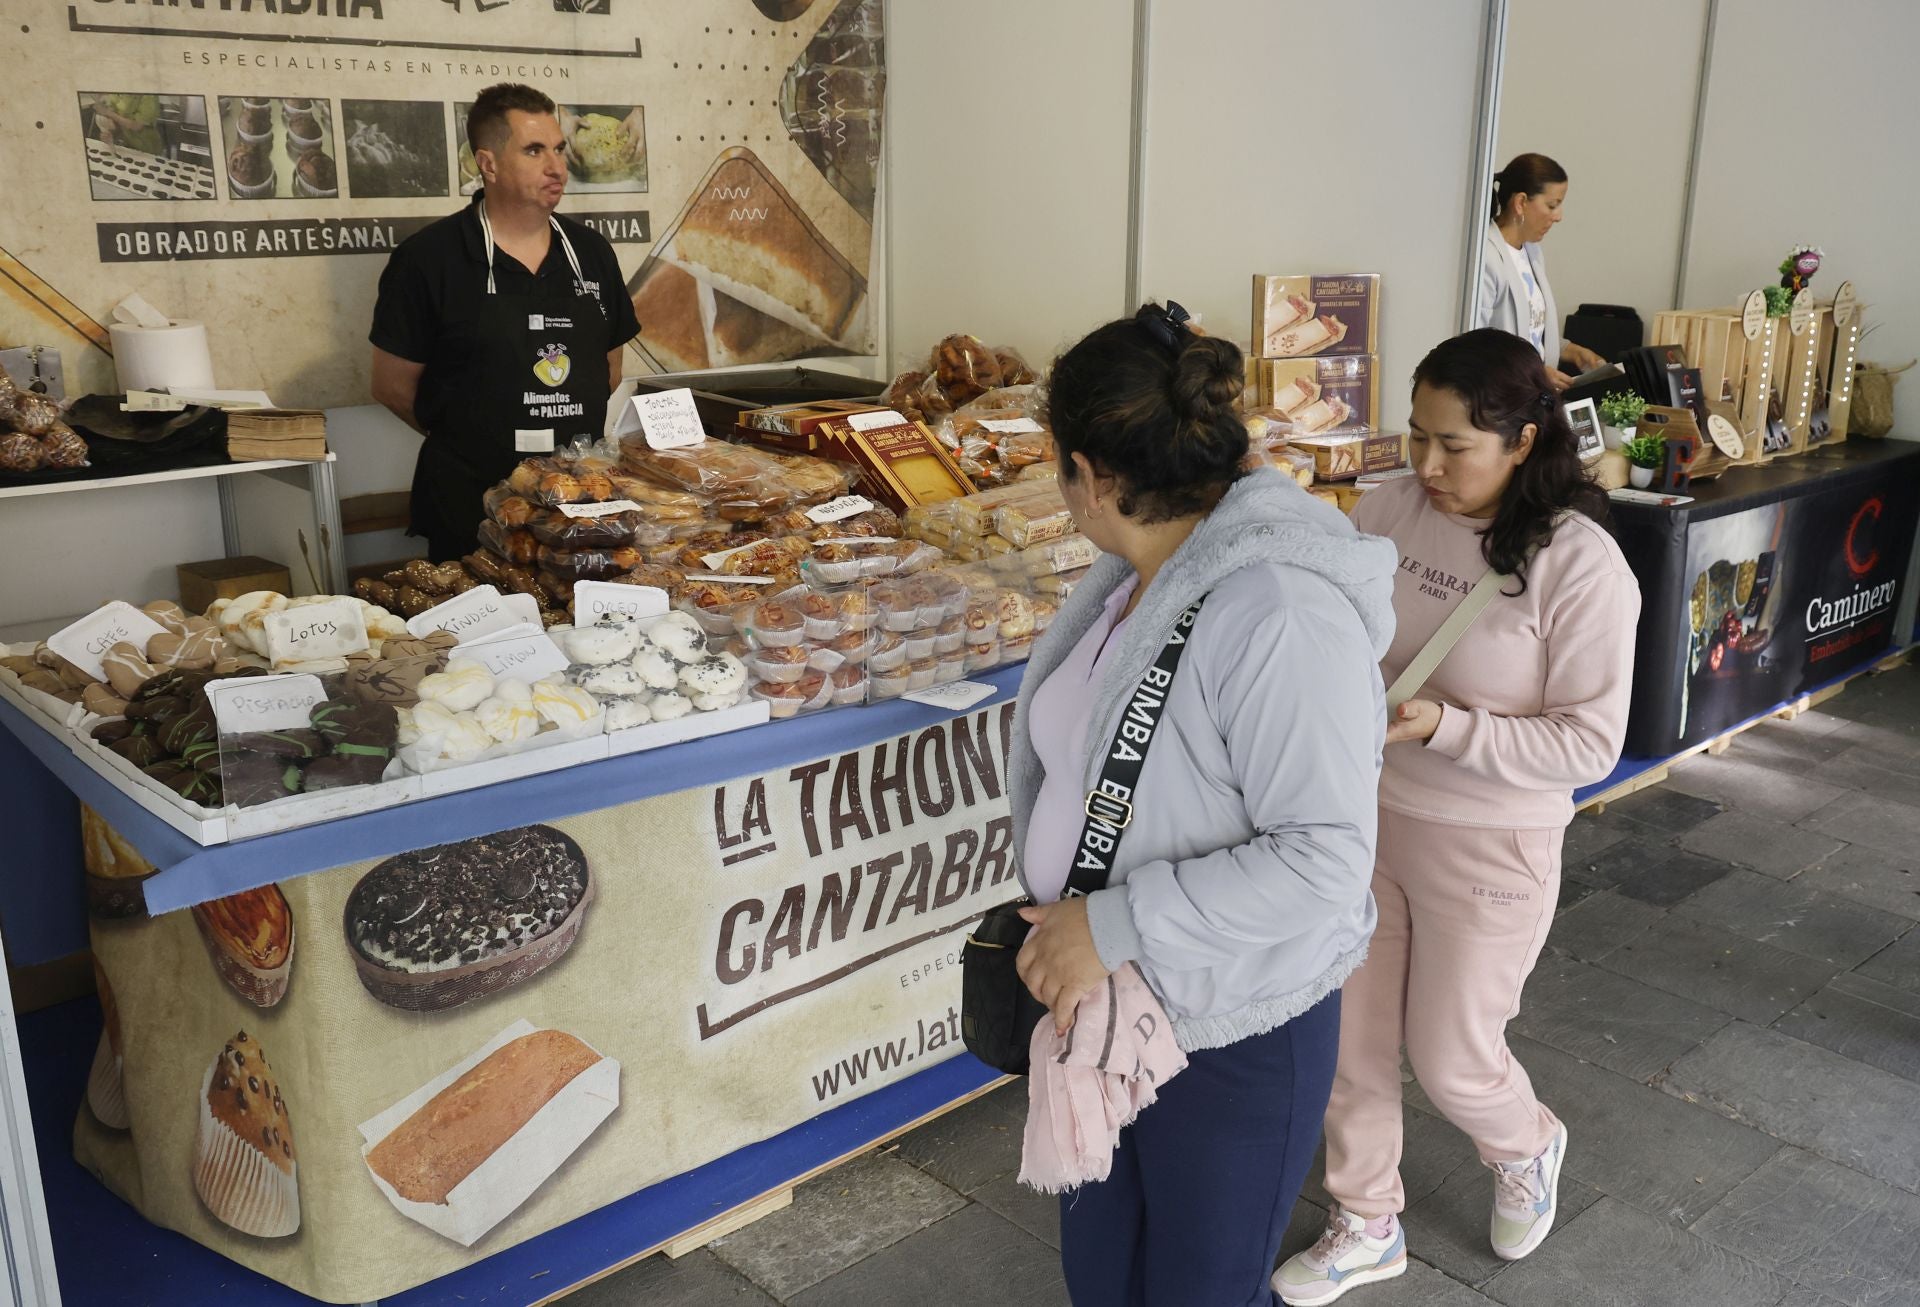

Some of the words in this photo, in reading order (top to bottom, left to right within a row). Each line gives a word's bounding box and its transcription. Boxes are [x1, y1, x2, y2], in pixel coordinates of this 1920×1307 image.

[183, 51, 392, 73] ESPECIALISTAS
[406, 61, 432, 74] EN
[444, 62, 571, 79] TRADICIÓN
[115, 229, 248, 256] OBRADOR
[523, 391, 570, 405] Alimentos
[529, 407, 539, 416] de
[541, 403, 584, 418] PALENCIA
[1399, 556, 1421, 574] LE
[1418, 583, 1449, 601] PARIS
[1805, 578, 1896, 633] Caminero
[1111, 665, 1173, 762] BIMBA
[714, 776, 772, 850] LA
[715, 815, 1016, 986] CANTABR
[1471, 886, 1486, 897] LE
[1488, 890, 1530, 901] MARAIS
[1491, 899, 1512, 907] PARIS
